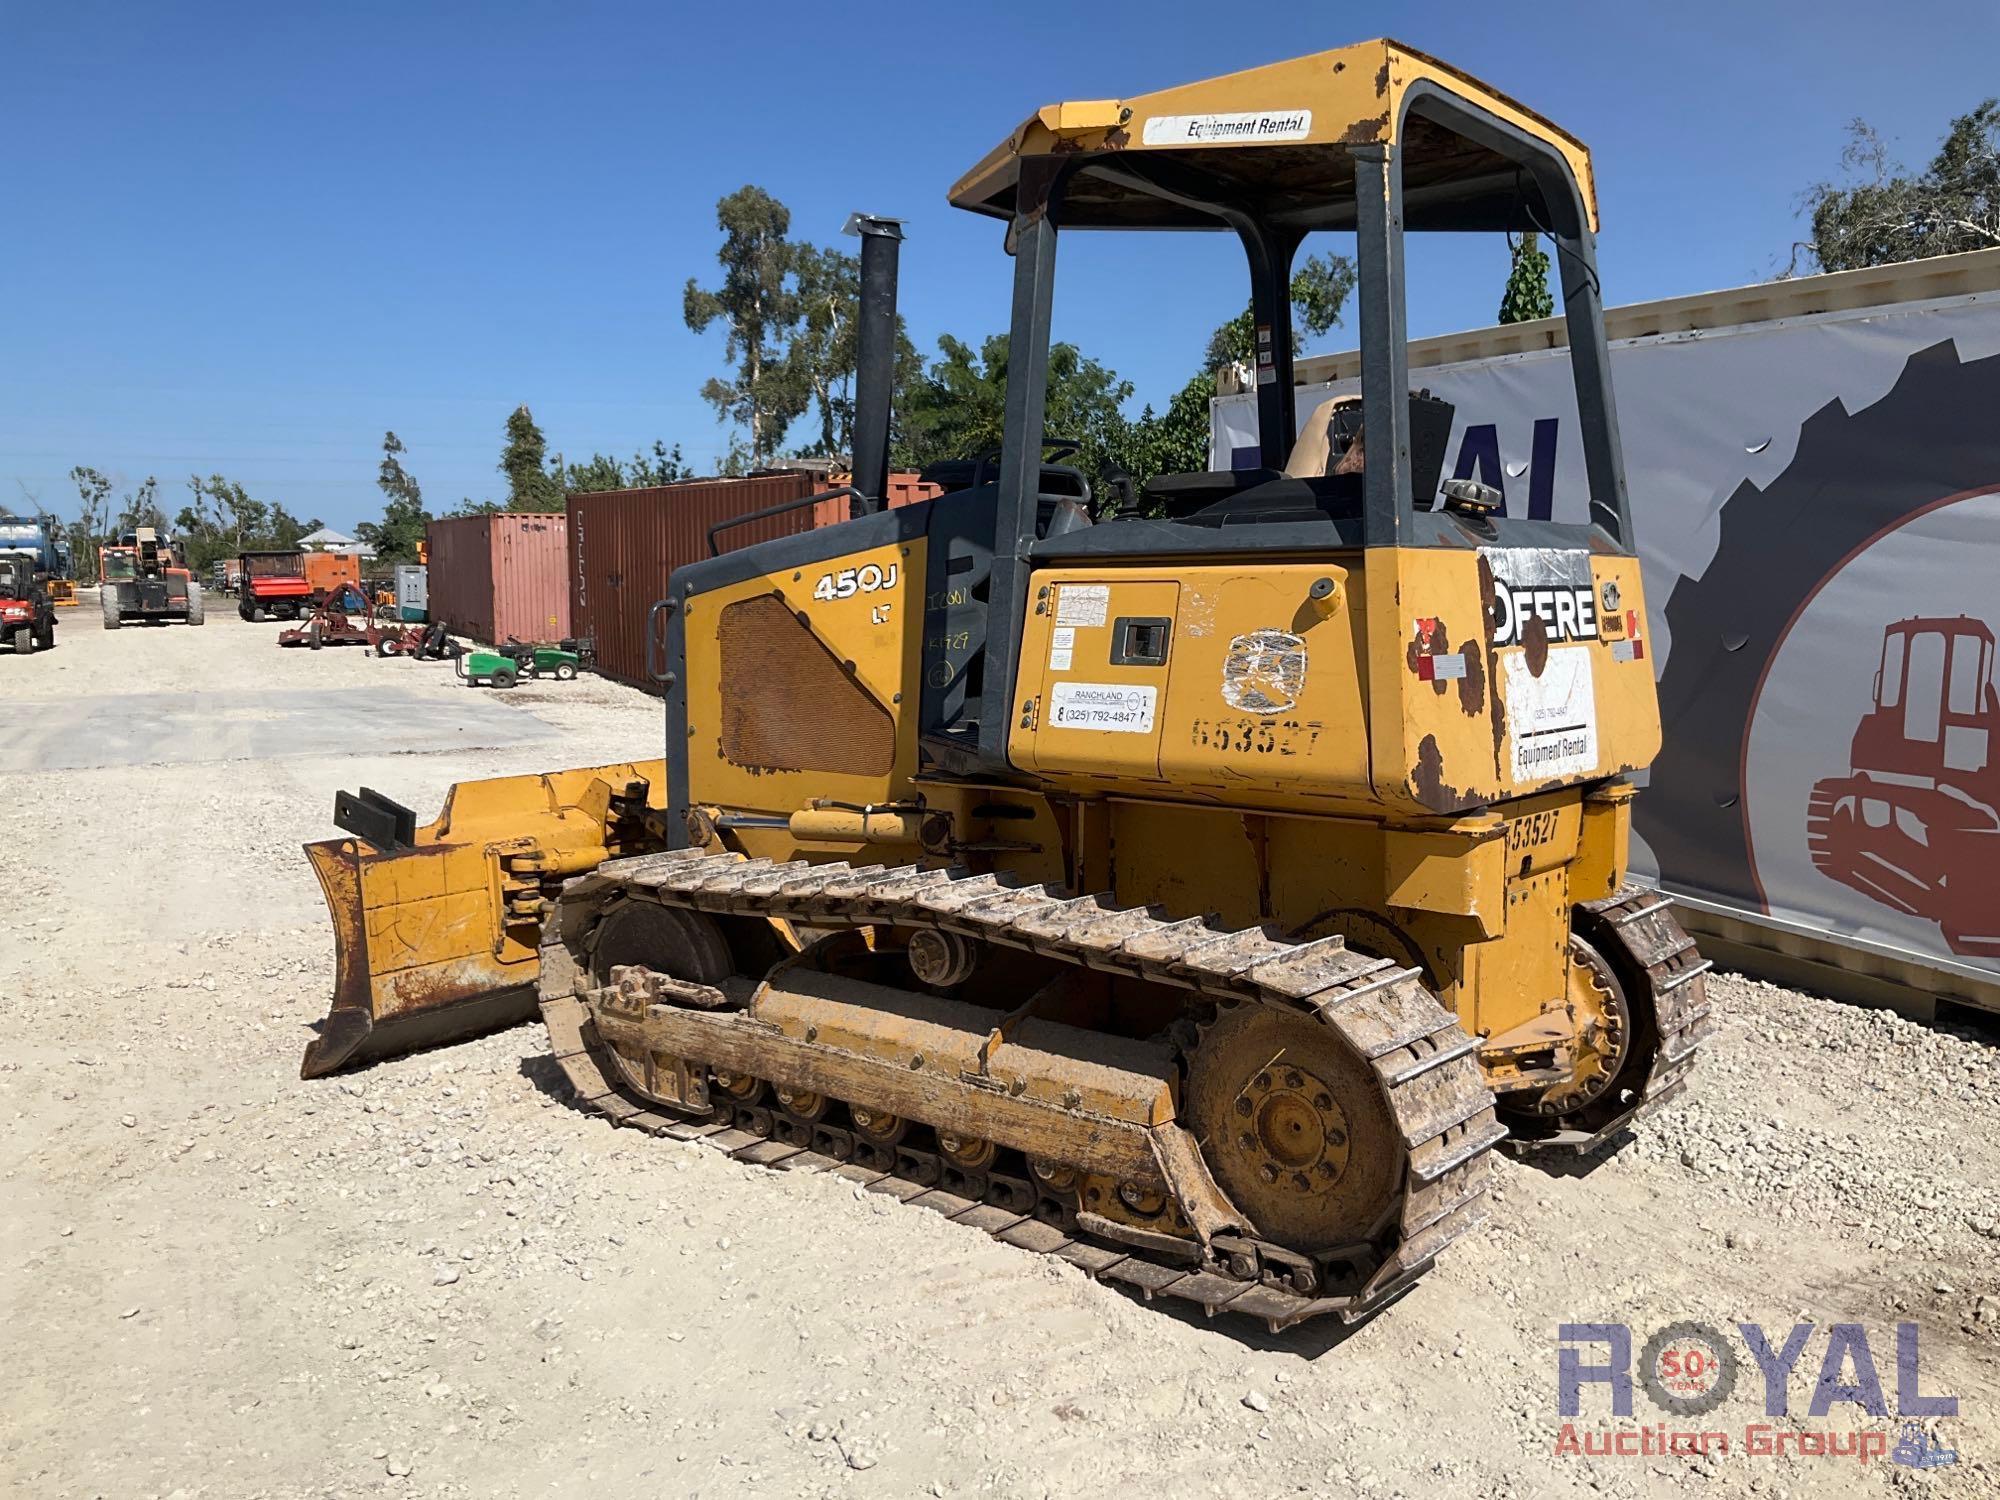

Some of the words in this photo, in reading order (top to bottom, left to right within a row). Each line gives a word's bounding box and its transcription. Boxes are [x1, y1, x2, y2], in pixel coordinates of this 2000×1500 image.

[1257, 116, 1304, 134] Rental
[812, 563, 898, 601] 450J
[872, 604, 892, 624] LT
[1074, 690, 1123, 701] RANCHLAND
[1065, 709, 1090, 722] (325)
[1092, 710, 1136, 723] 792-4847
[1517, 739, 1562, 770] Equipment
[1562, 734, 1587, 757] Rental
